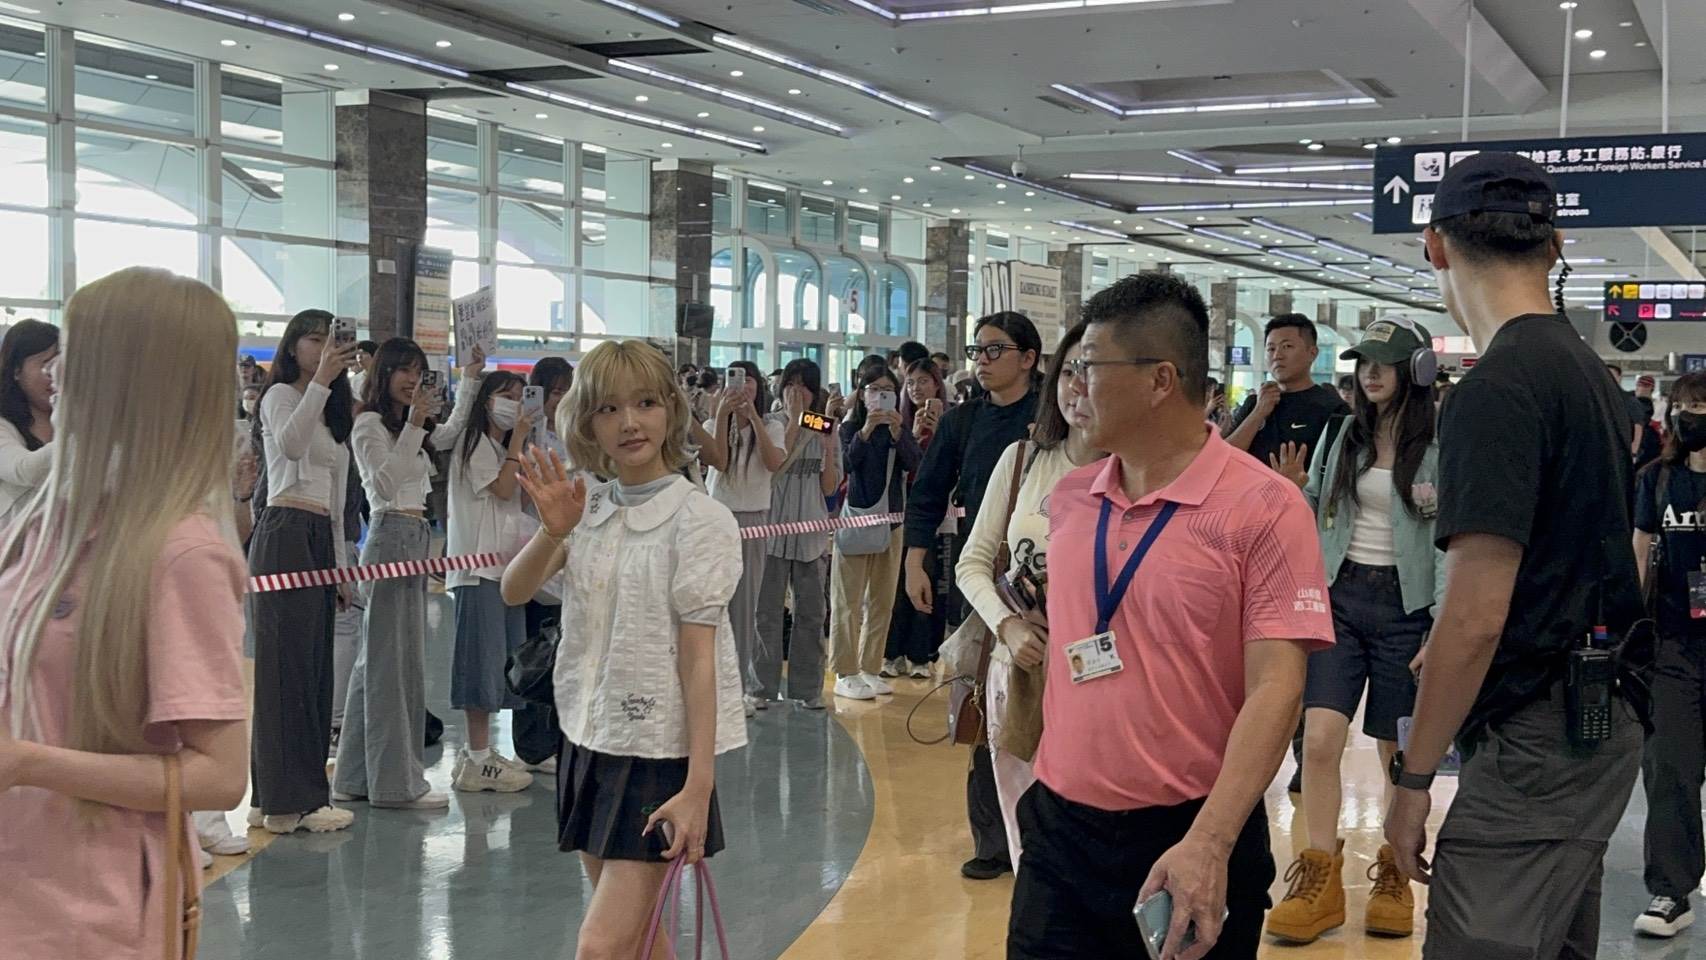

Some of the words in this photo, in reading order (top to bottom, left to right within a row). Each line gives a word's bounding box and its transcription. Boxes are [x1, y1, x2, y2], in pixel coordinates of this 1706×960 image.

[1629, 161, 1666, 171] Workers
[1099, 635, 1113, 652] 5
[481, 764, 503, 779] NY
